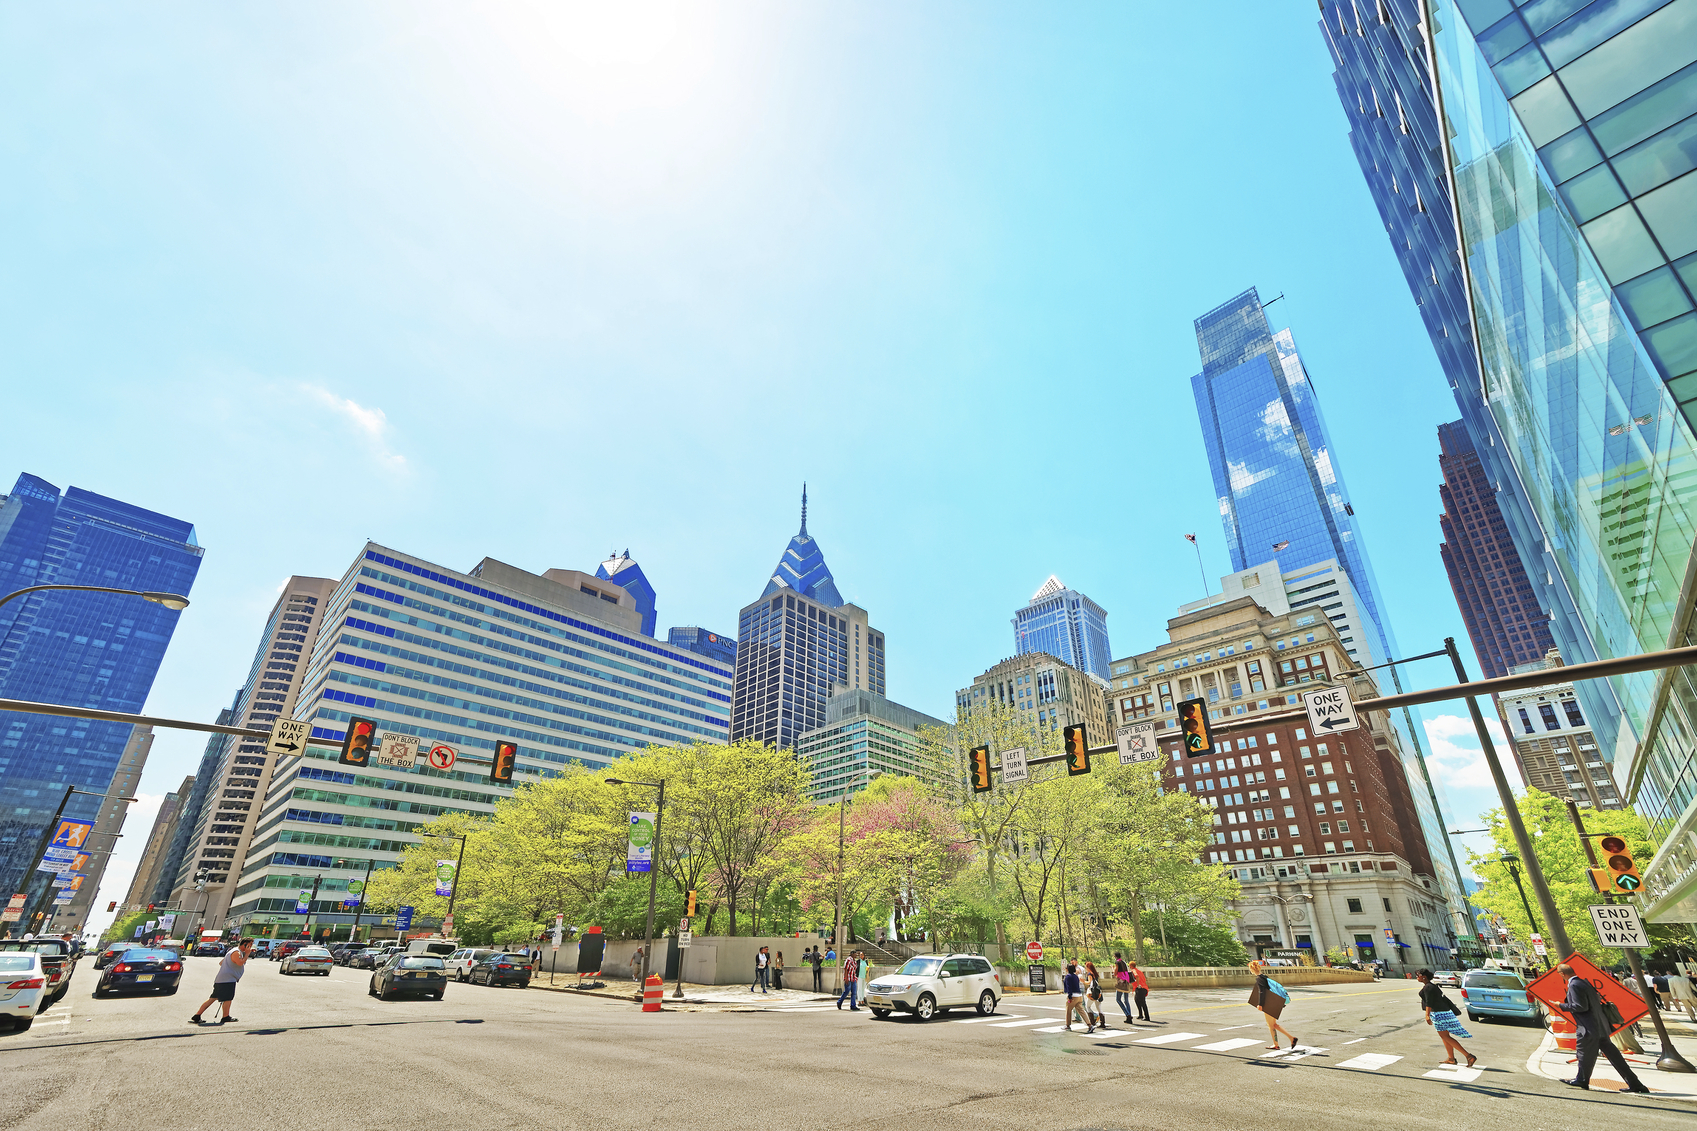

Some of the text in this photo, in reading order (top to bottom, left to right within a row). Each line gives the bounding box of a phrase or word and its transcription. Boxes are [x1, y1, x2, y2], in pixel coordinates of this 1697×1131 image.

[716, 636, 733, 650] PNC
[1313, 691, 1341, 705] ONE
[1315, 703, 1343, 717] WAY
[281, 722, 304, 733] ONE
[1134, 724, 1152, 733] BLOCK
[278, 731, 302, 741] WAY
[400, 736, 419, 745] BLOCK
[1006, 751, 1020, 760] LEFT
[1122, 750, 1156, 763] THE BOX
[380, 756, 413, 768] THE BOX
[1006, 760, 1022, 769] TURN
[1005, 769, 1025, 779] SIGNAL
[1597, 908, 1630, 919] END
[1602, 921, 1636, 931] ONE
[1604, 933, 1638, 943] WAY
